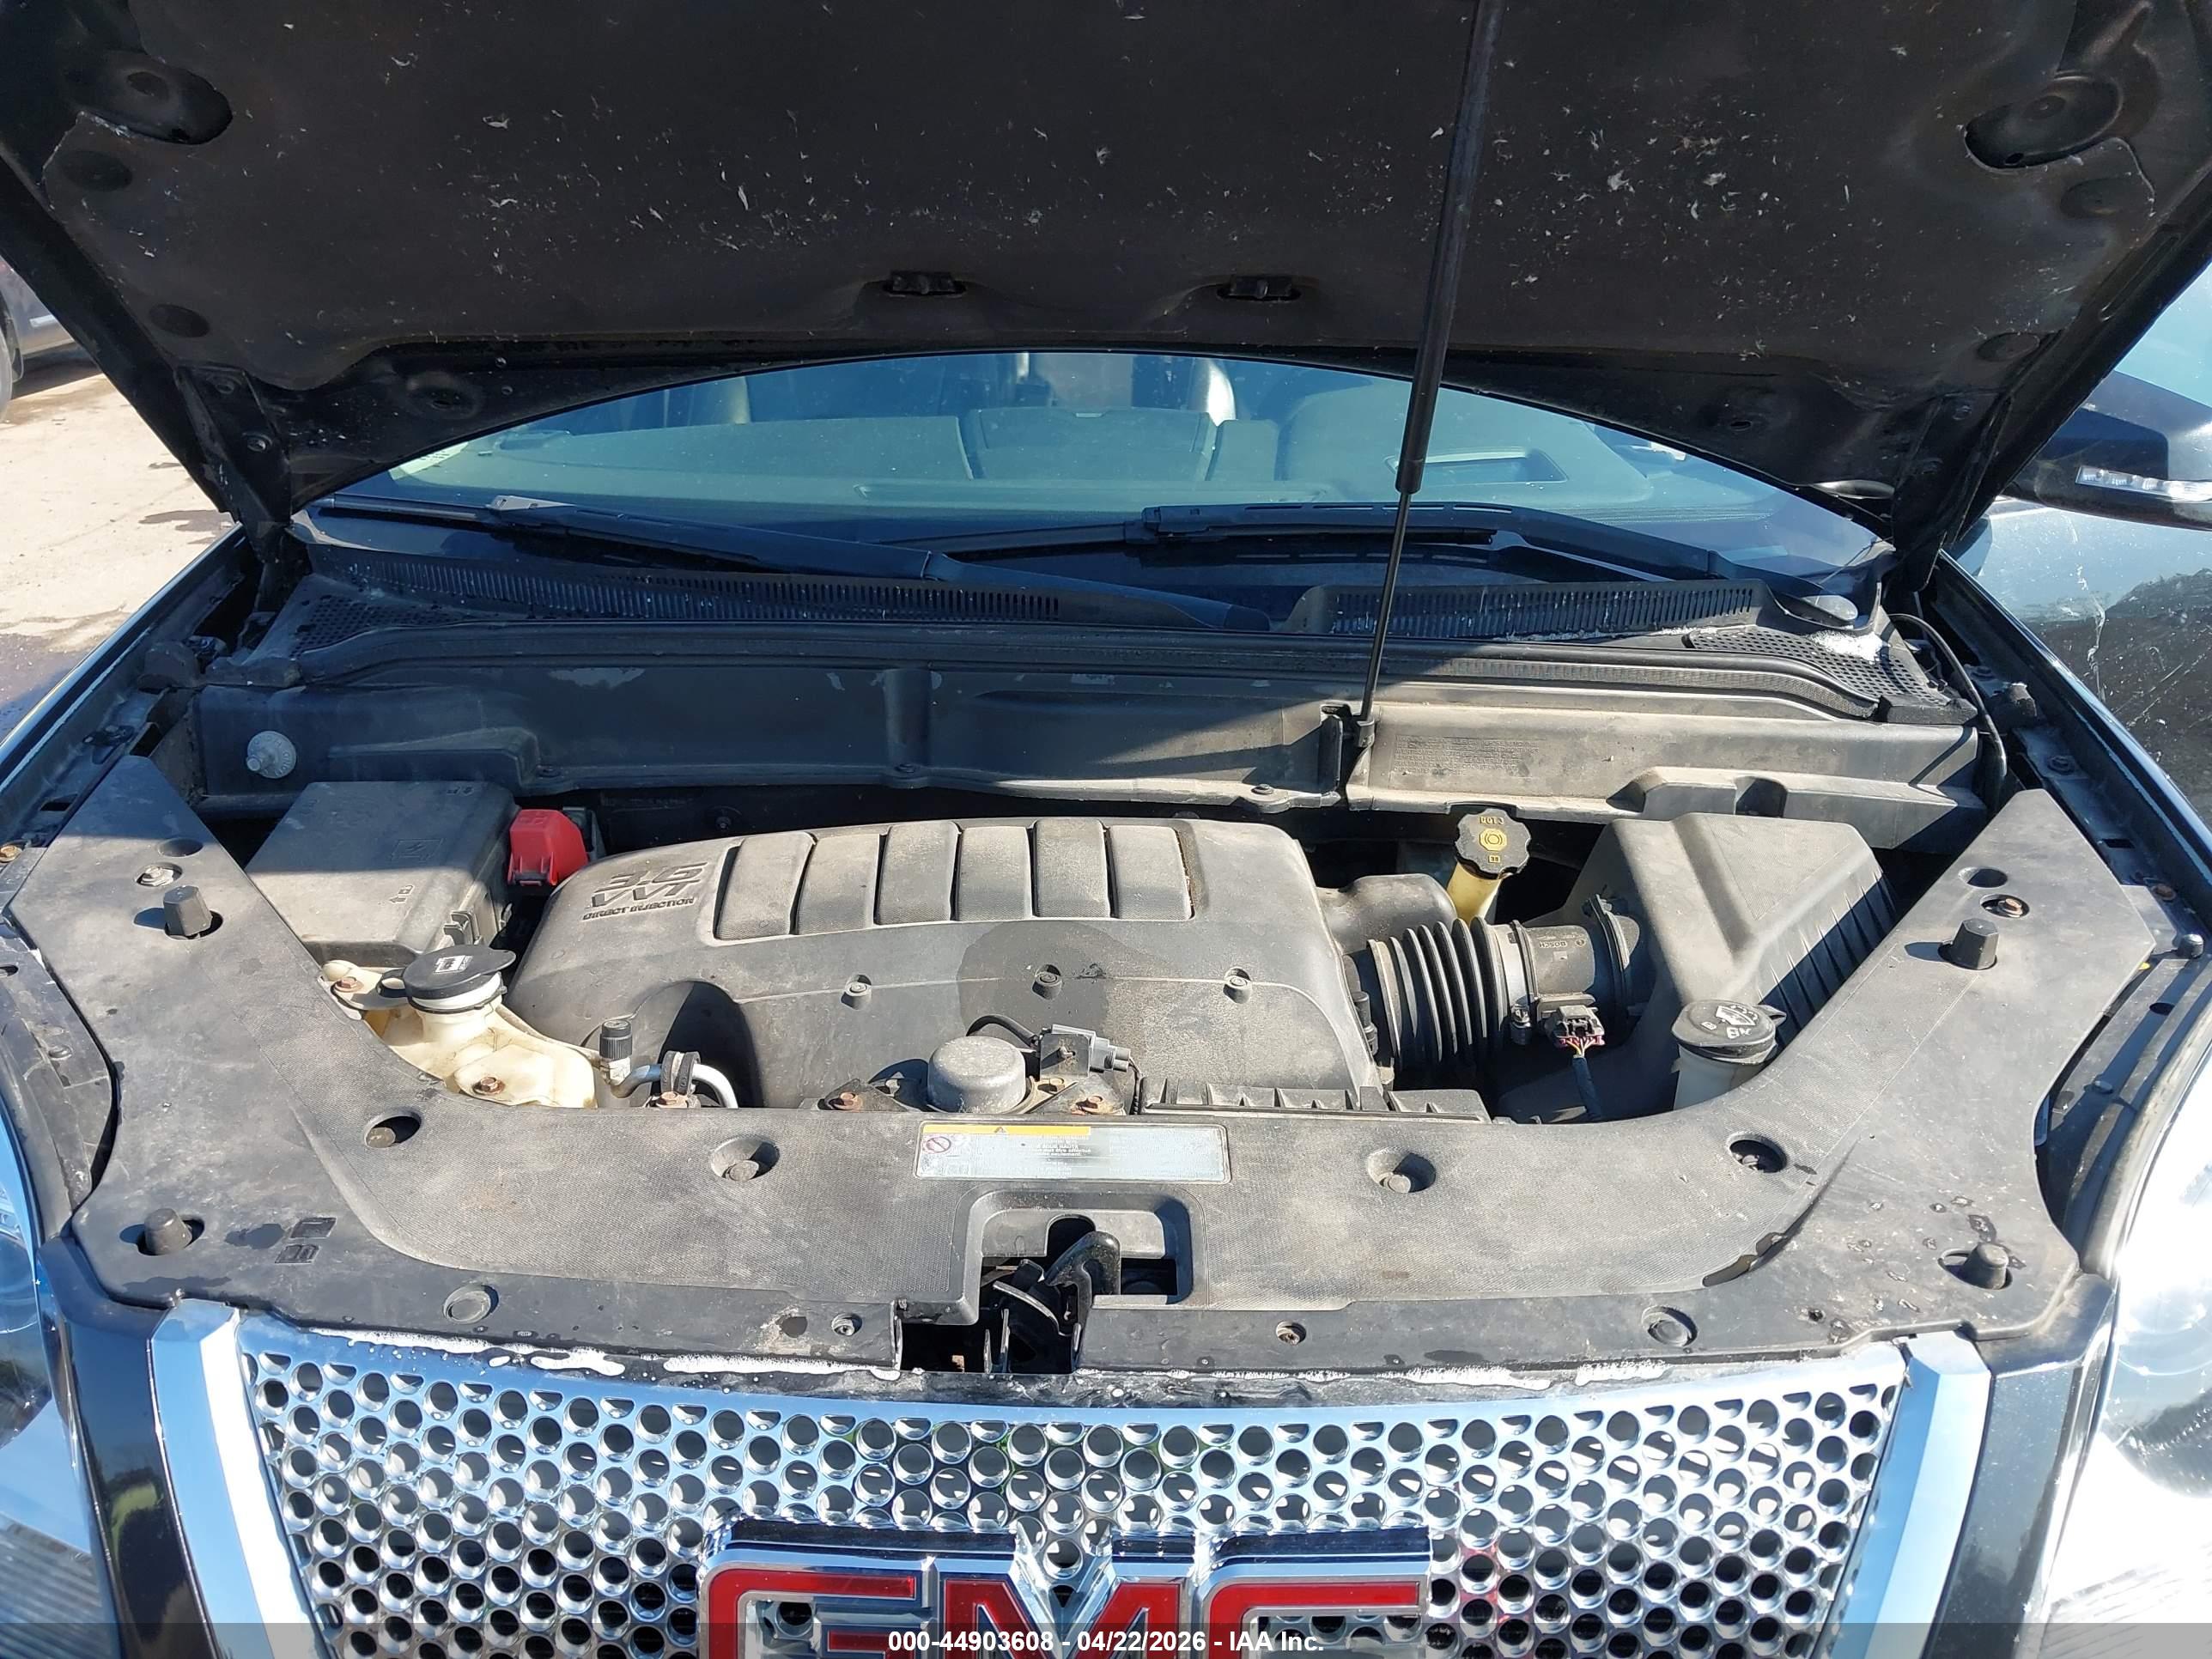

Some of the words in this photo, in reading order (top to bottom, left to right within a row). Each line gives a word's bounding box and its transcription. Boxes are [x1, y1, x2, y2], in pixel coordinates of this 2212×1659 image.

[593, 861, 708, 893] 3.6
[586, 879, 702, 908] VVT
[583, 906, 630, 921] DIRECT
[629, 897, 696, 912] INJECTION
[1539, 940, 1567, 949] BOSCH
